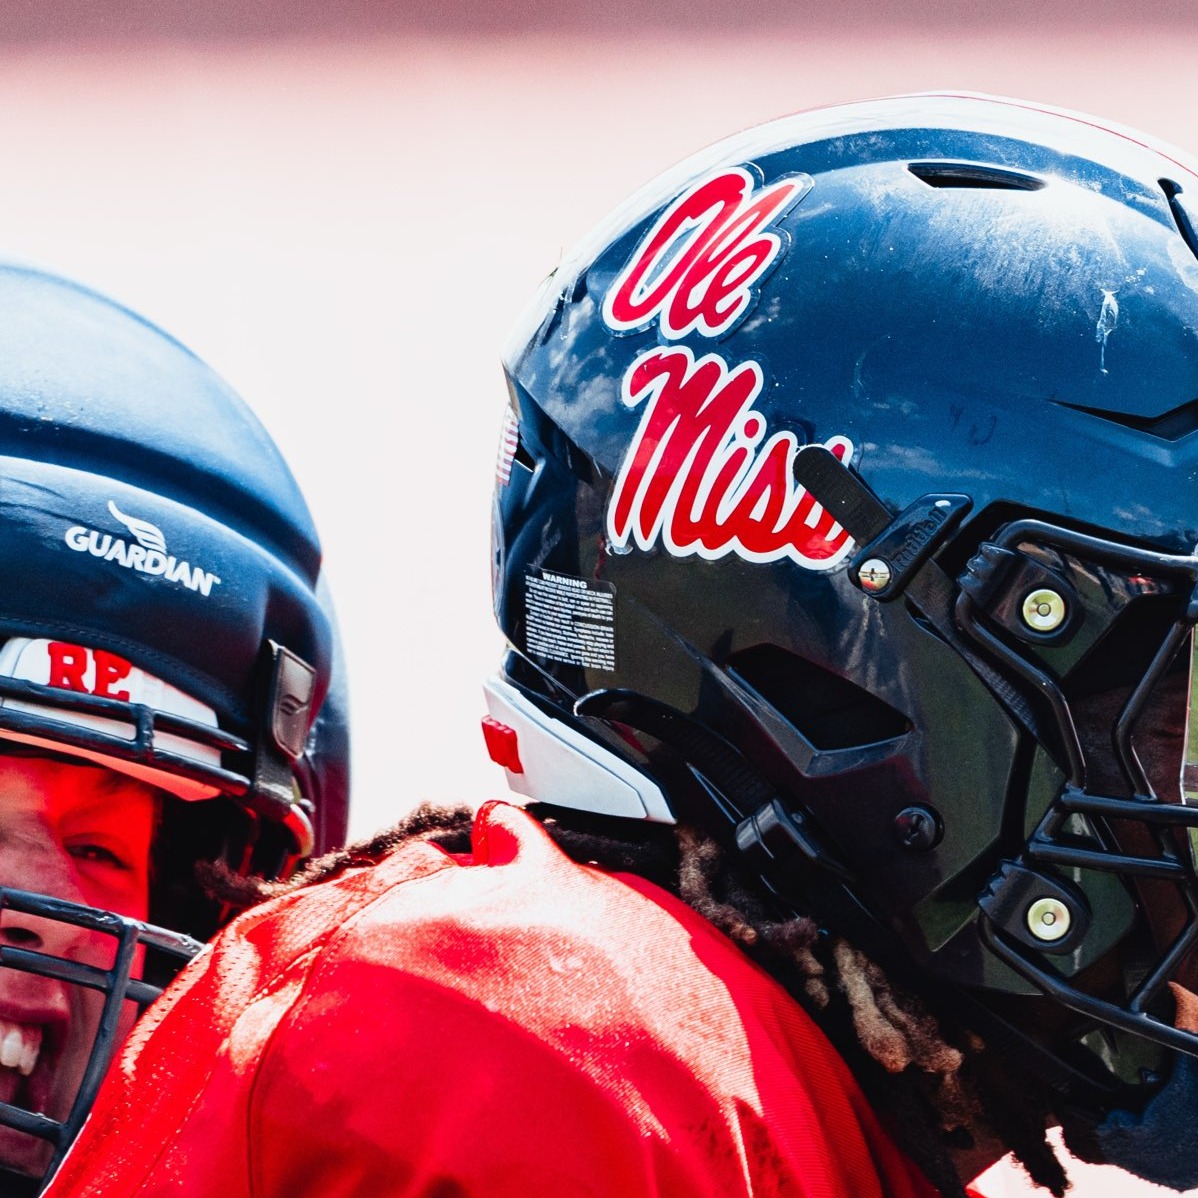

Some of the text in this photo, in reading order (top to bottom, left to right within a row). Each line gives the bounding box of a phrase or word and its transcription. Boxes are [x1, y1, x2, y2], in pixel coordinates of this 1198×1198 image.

[602, 166, 803, 340] Ole
[65, 526, 217, 596] GUARDIAN
[542, 572, 588, 589] WARNING
